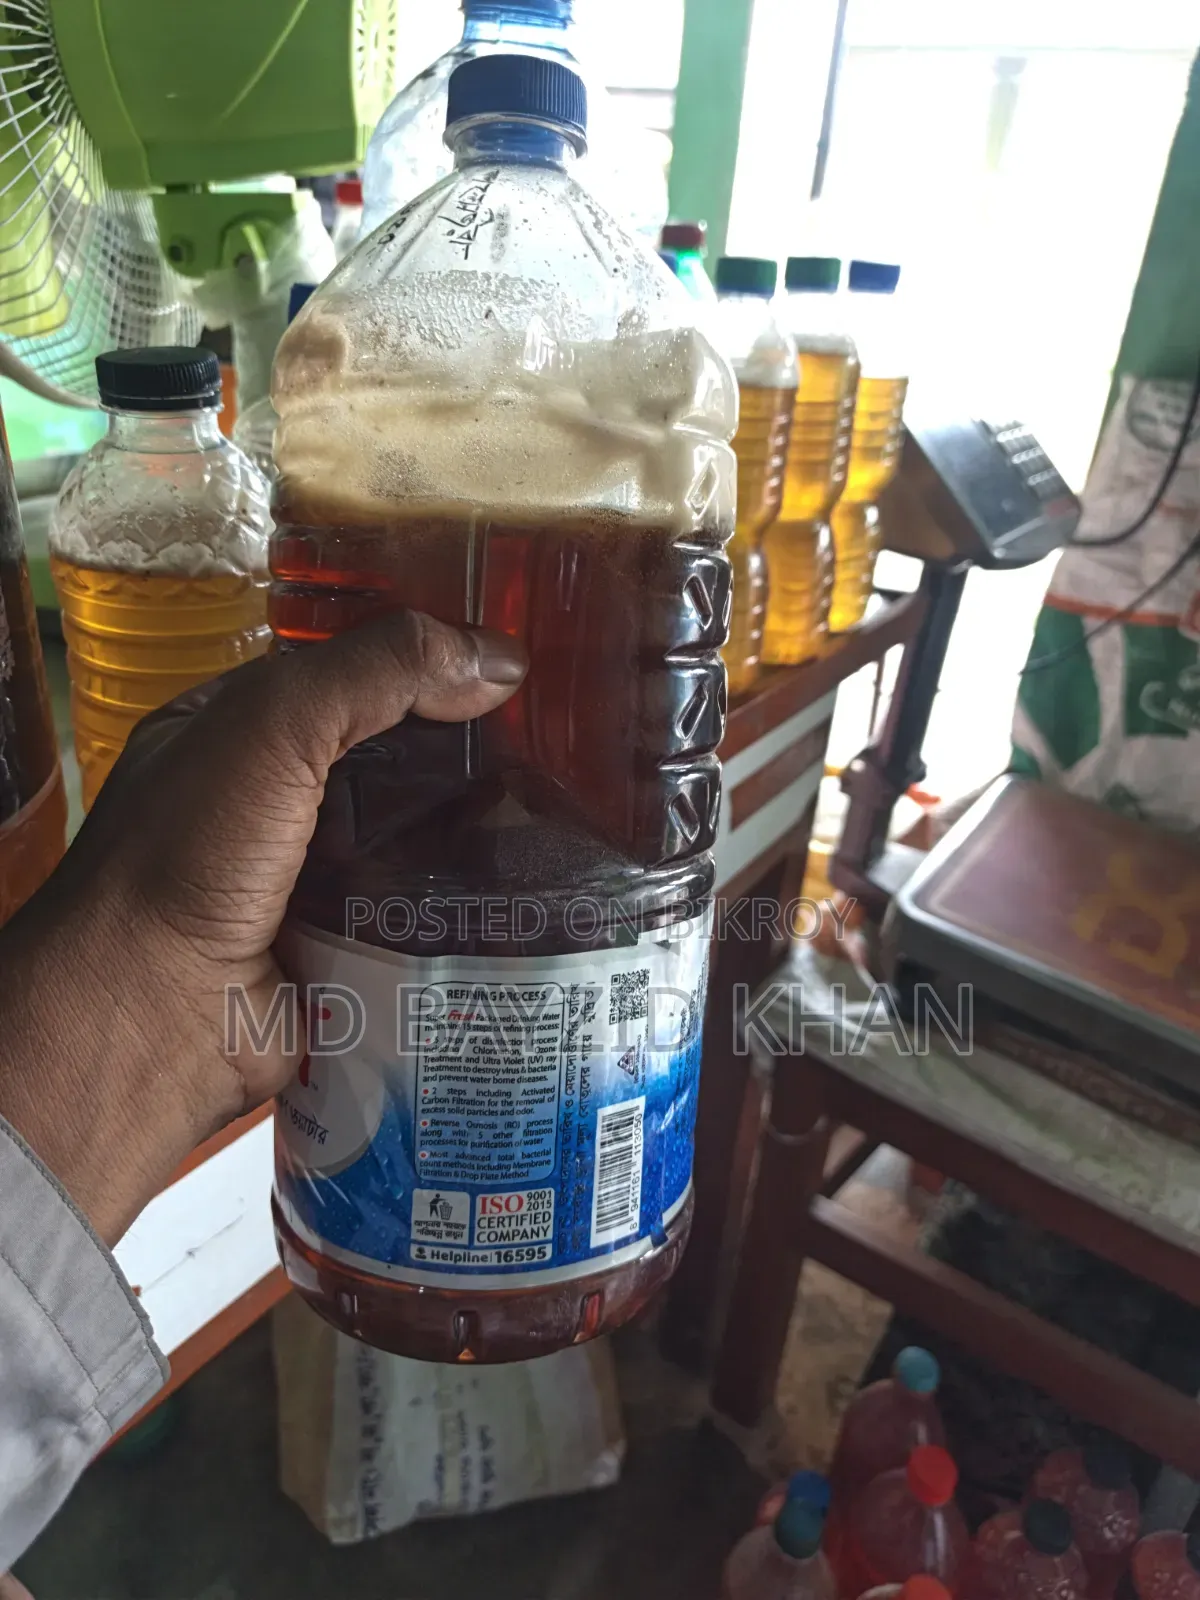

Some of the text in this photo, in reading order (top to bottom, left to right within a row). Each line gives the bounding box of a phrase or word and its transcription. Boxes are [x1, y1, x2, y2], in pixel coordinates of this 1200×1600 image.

[447, 989, 547, 1001] REFINING PROCESS
[566, 983, 580, 1018] তারিখ
[542, 1013, 560, 1021] Water
[424, 1023, 460, 1031] mintain
[472, 1024, 492, 1033] steps
[502, 1024, 531, 1033] refining
[443, 1036, 464, 1045] eps
[468, 1036, 478, 1044] of
[481, 1036, 524, 1045] disnfetion
[531, 1036, 558, 1045] process
[472, 1046, 521, 1056] Chloriation,
[423, 1055, 557, 1065] Treatment and Ultra Violet (UV) ray
[422, 1064, 462, 1073] Treatment
[472, 1065, 499, 1077] destroy
[501, 1066, 520, 1074] virus
[521, 1065, 527, 1074] &
[528, 1063, 557, 1073] bacteria
[422, 1074, 437, 1082] and
[438, 1073, 468, 1084] prevent
[469, 1075, 491, 1084] water
[517, 1073, 548, 1083] diseases.
[432, 1085, 555, 1099] 2 steps including Activated
[421, 1094, 555, 1107] Carbon Filtration for the removal of
[421, 1106, 535, 1117] excess solid particles and odor.
[430, 1117, 553, 1131] Reverse Osmosis (RO) process
[420, 1129, 443, 1138] along
[452, 1129, 469, 1138] with
[493, 1131, 514, 1139] other
[523, 1127, 553, 1137] filtration
[420, 1138, 457, 1148] processes
[458, 1138, 469, 1147] for
[470, 1139, 513, 1149] purification
[523, 1138, 544, 1146] water
[430, 1148, 552, 1162] Most advanced total bacterial
[420, 1158, 551, 1171] count methods including Membrane
[419, 1168, 452, 1178] Filtration
[460, 1170, 479, 1181] Drop
[481, 1171, 499, 1180] Plate
[500, 1169, 529, 1179] Method
[629, 1113, 643, 1231] 8 941161 113050
[479, 1190, 552, 1215] ISO 9001
[526, 1200, 552, 1212] 2015
[477, 1211, 552, 1229] CERTIFIED
[476, 1225, 550, 1243] COMPANY
[430, 1246, 547, 1264] Helpline 16595
